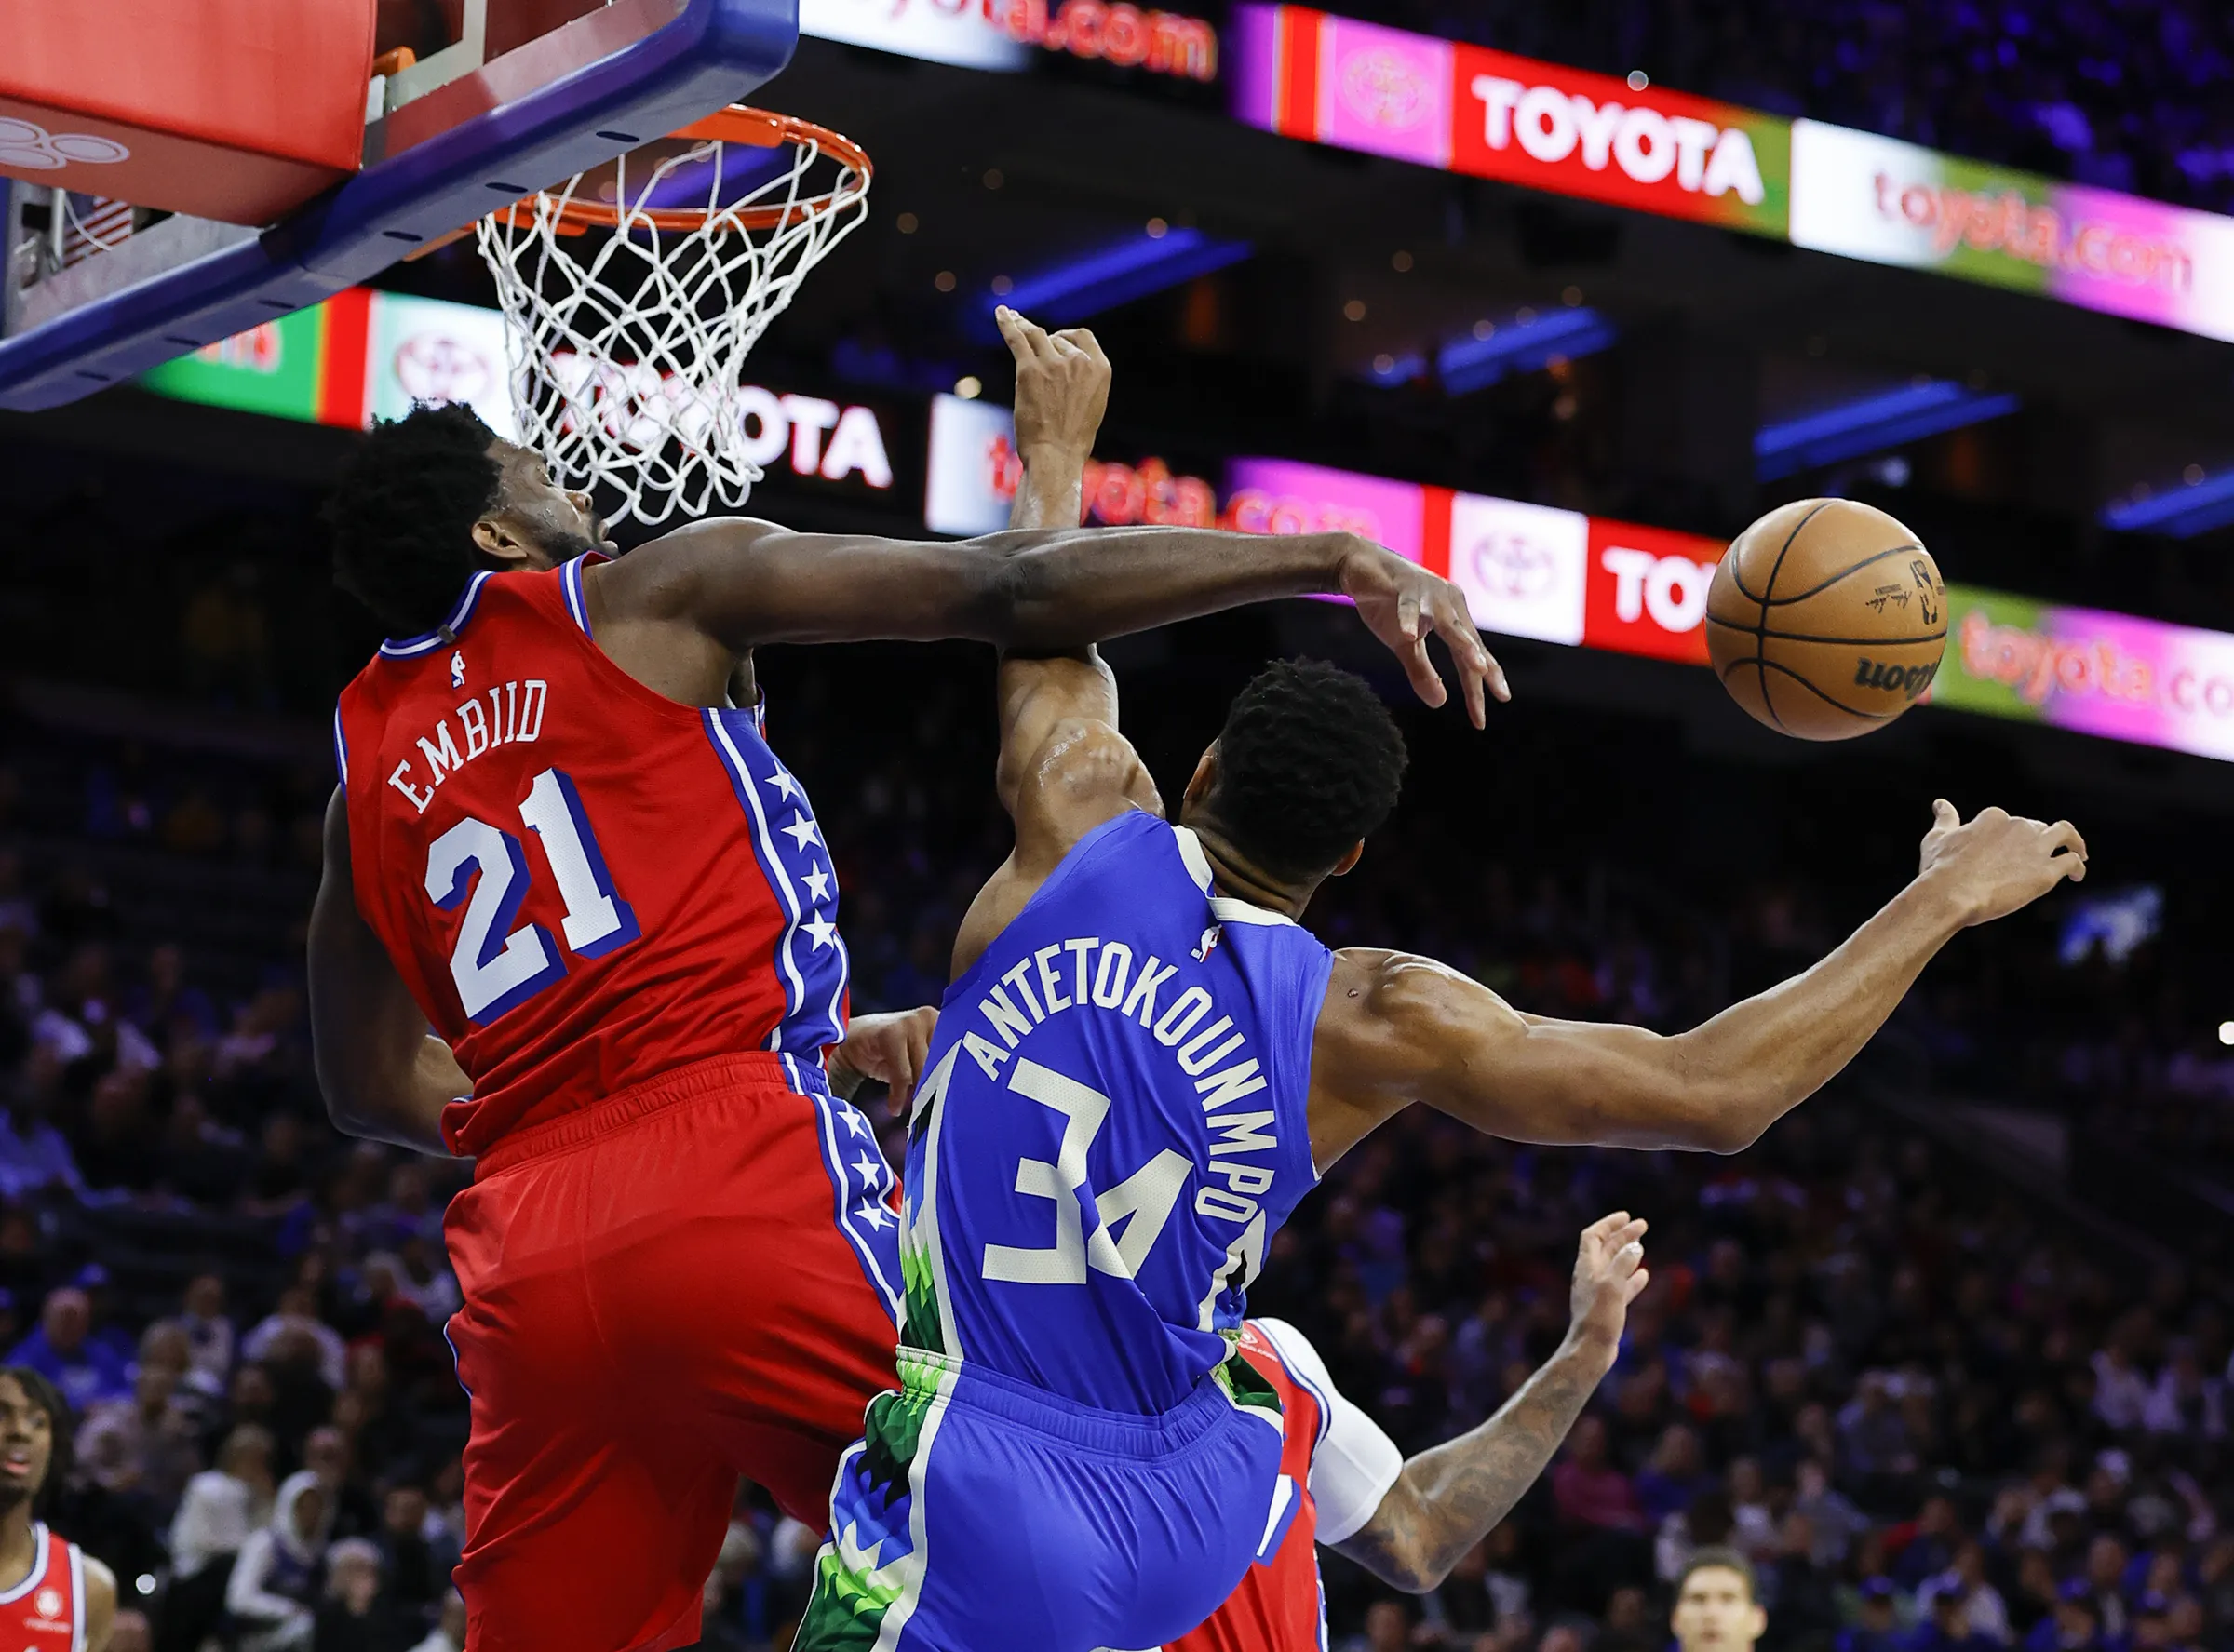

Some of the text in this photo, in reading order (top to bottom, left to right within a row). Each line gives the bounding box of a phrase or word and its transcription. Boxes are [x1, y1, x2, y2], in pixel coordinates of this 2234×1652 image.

[1471, 73, 1765, 205] TOYOTA
[1873, 170, 2193, 293] toyota.com
[1600, 544, 1716, 633] TO
[388, 679, 547, 814] EMBIID
[424, 767, 642, 1026] 21
[962, 936, 1278, 1224] ANTETOKOUNMPO
[981, 1056, 1195, 1285] 34
